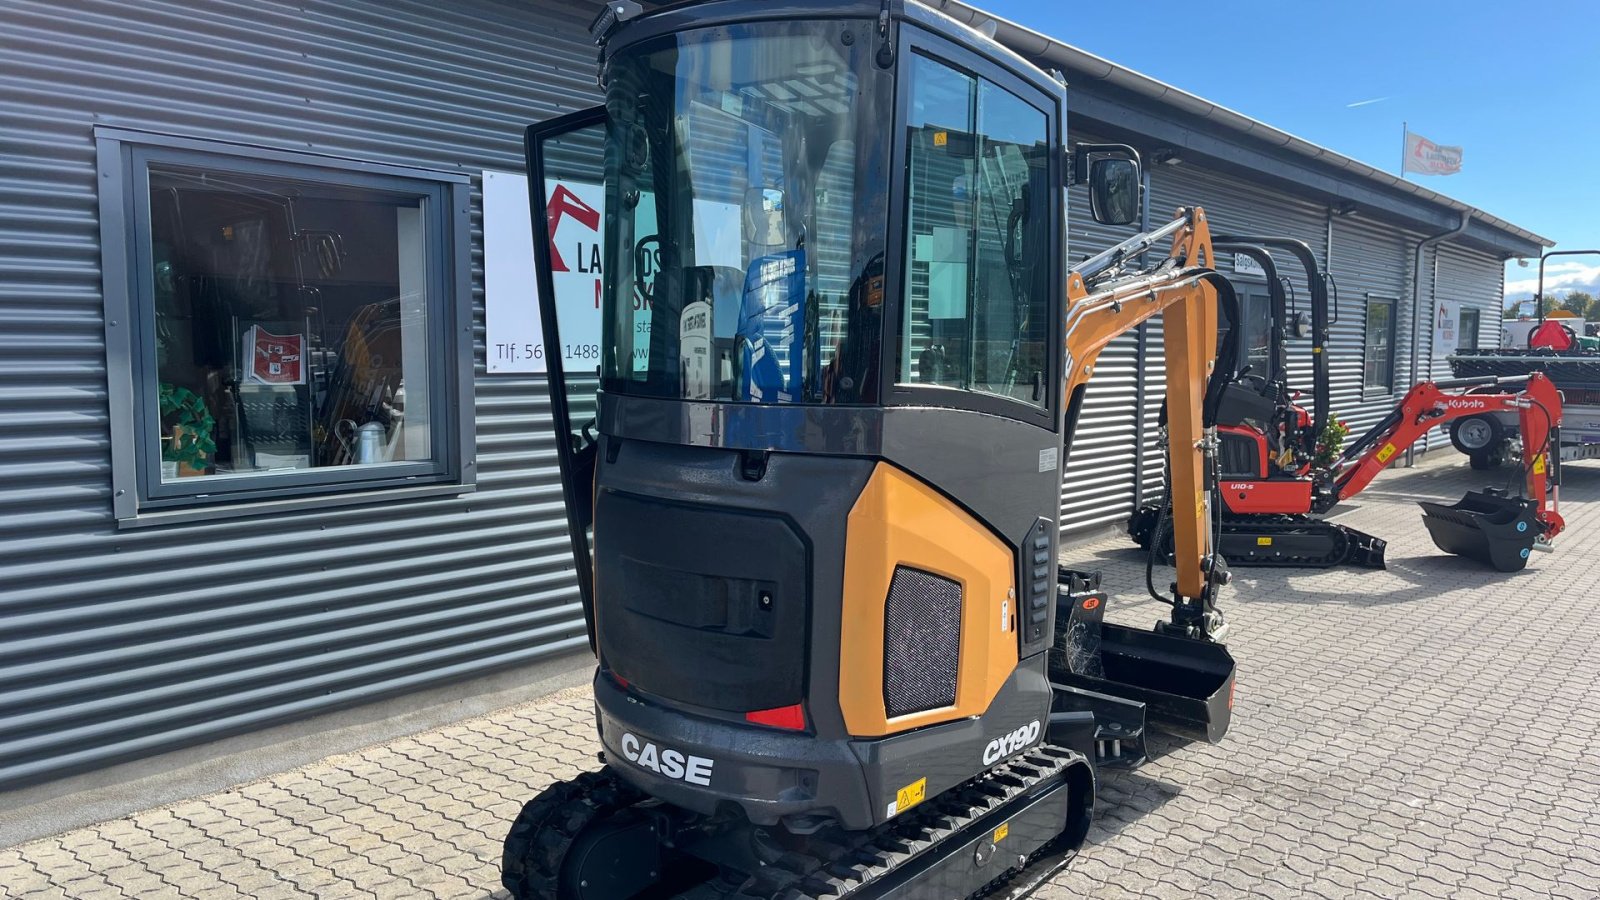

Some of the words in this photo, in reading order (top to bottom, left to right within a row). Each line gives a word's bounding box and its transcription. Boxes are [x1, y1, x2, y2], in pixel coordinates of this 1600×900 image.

[495, 344, 520, 362] Tlf.
[1448, 399, 1485, 409] Kubota
[983, 720, 1040, 766] CX19D
[621, 732, 714, 787] CASE
